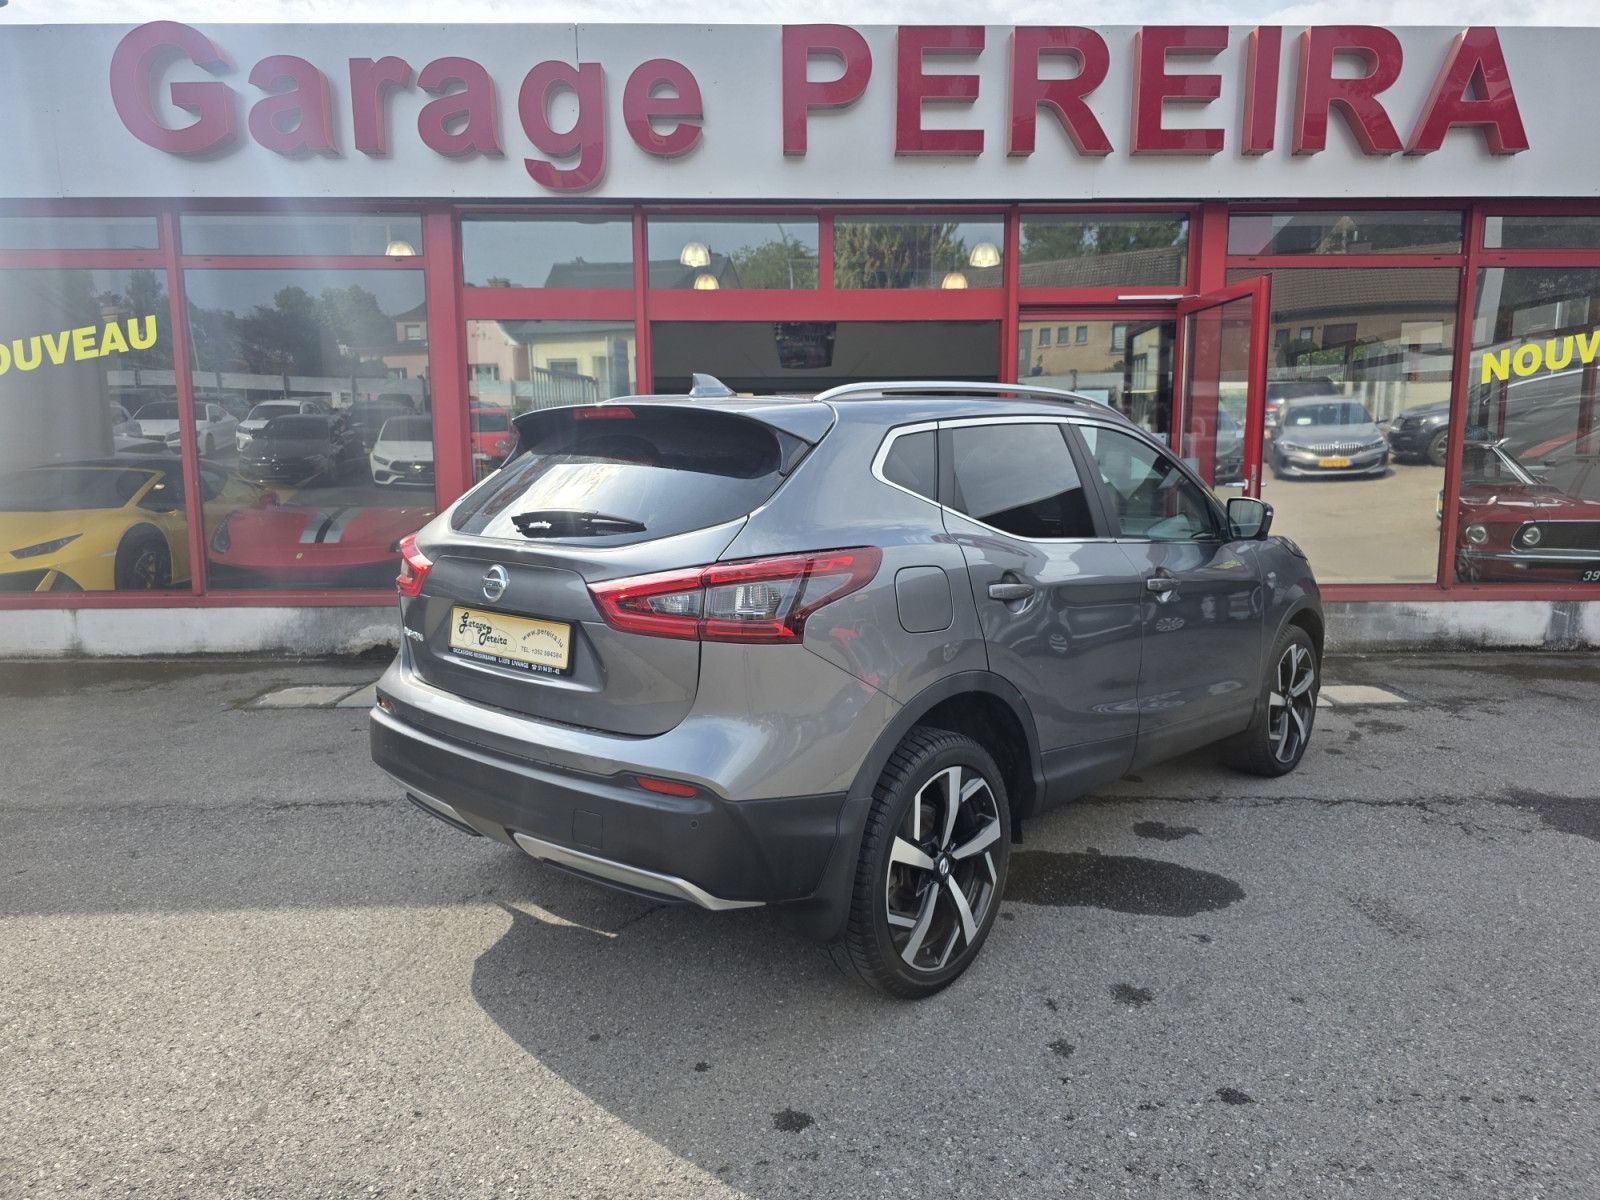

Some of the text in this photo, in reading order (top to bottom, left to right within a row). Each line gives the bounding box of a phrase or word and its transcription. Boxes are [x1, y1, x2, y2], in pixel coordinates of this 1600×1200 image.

[110, 20, 1530, 193] Garage PEREIRA
[1481, 330, 1600, 385] NOUV
